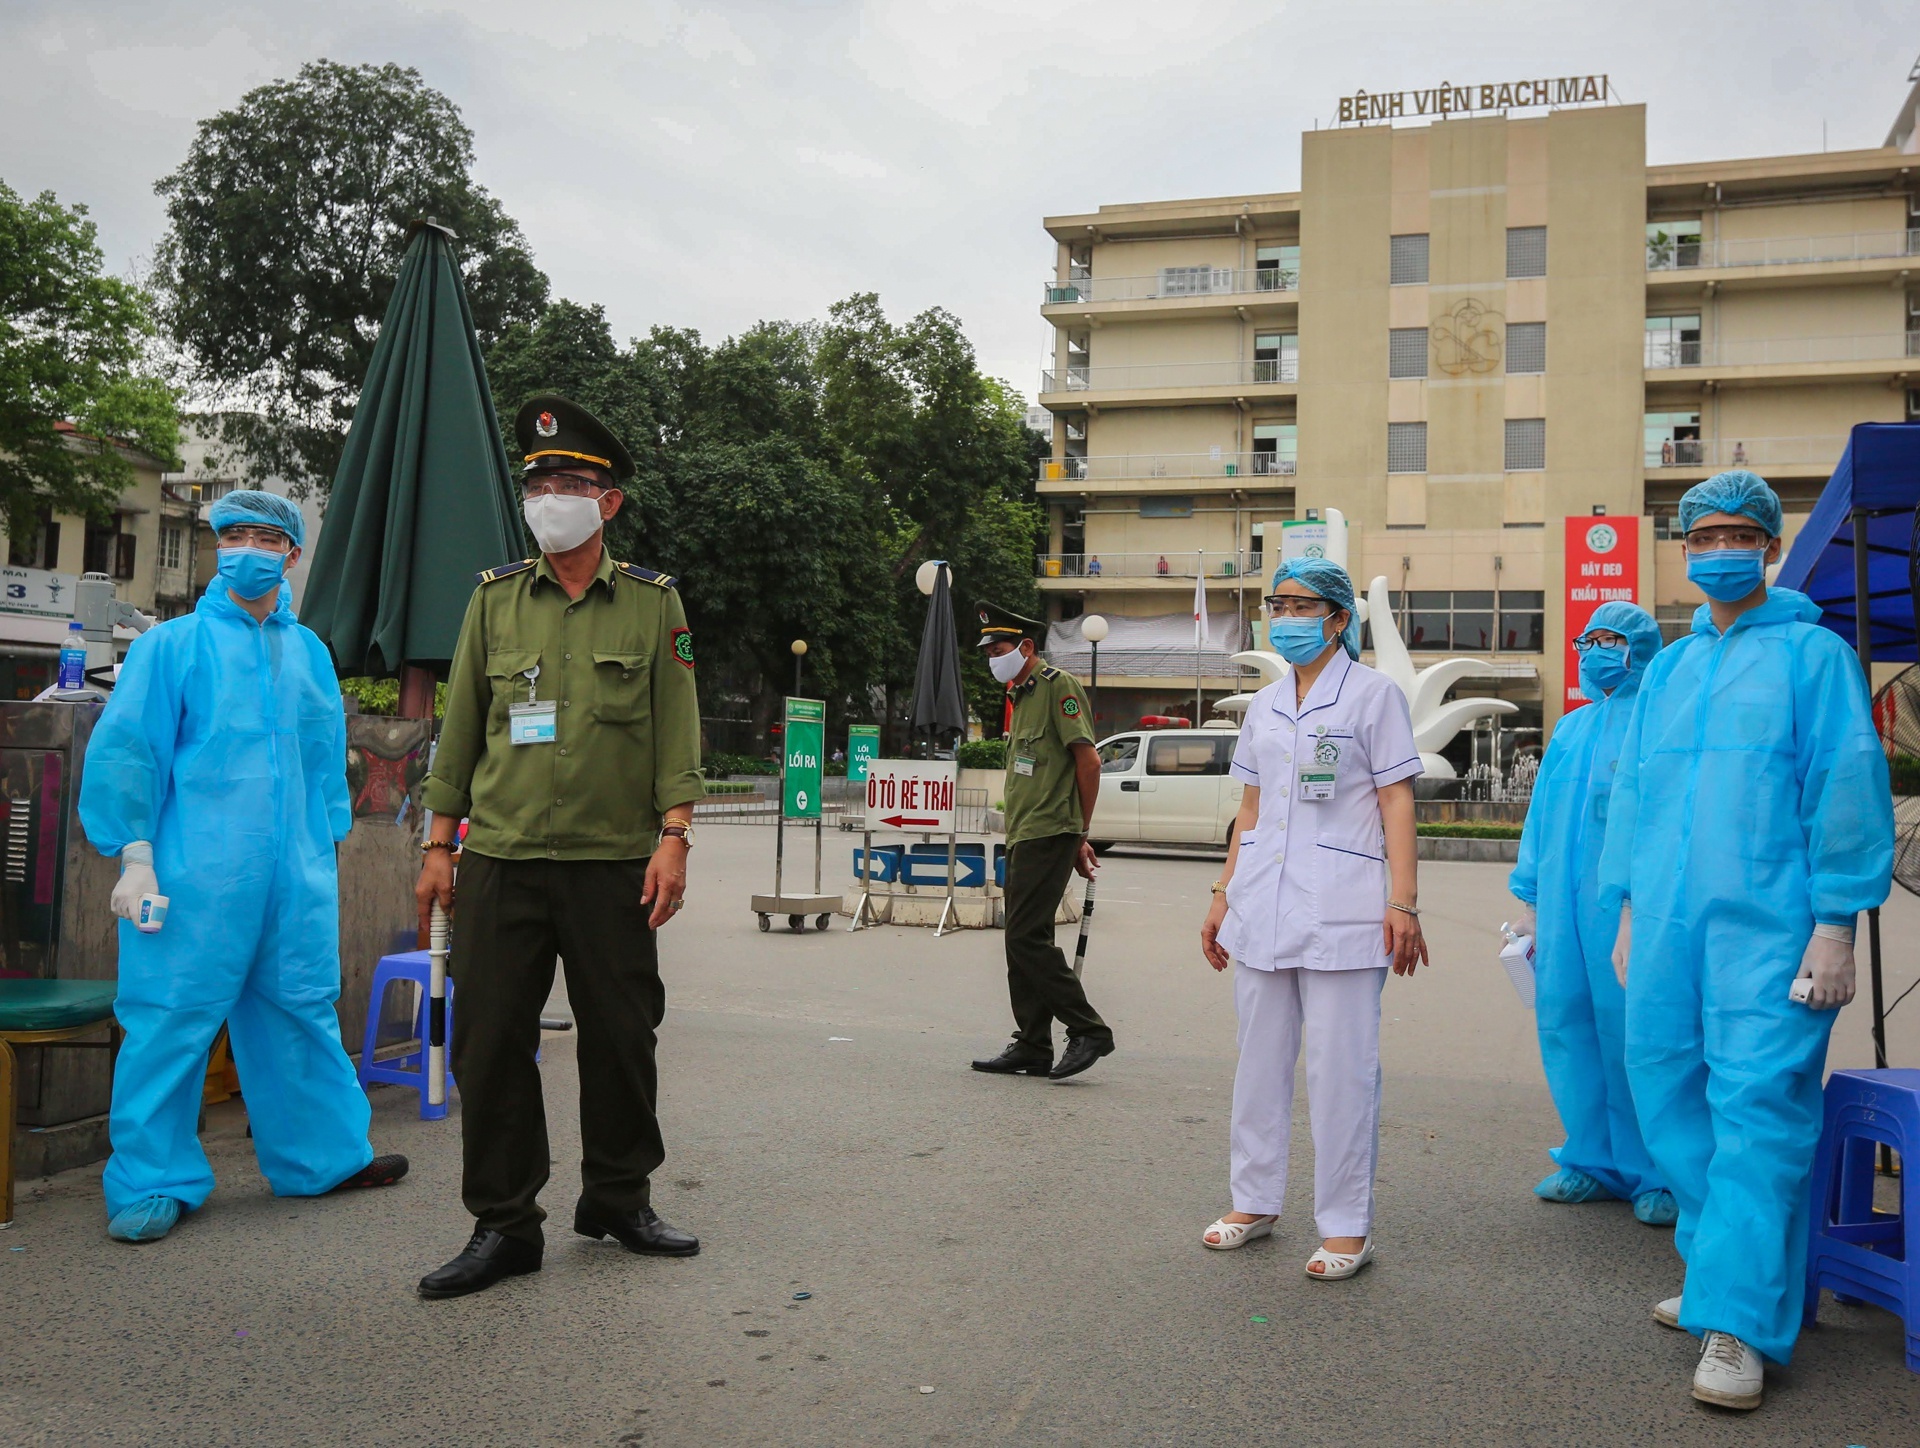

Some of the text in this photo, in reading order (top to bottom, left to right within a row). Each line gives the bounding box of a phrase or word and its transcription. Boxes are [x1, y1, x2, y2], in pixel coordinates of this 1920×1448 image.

[1339, 74, 1607, 127] BỆNH VIỆN BẠCH MAI
[2, 570, 27, 578] MAI
[1581, 561, 1622, 576] HÃY ĐEO
[7, 584, 26, 599] 3
[1600, 588, 1632, 600] TRANG
[858, 744, 868, 753] LỐI
[788, 750, 816, 769] LỐI RA
[867, 772, 954, 811] Ô TÔ RẼ TRÁI
